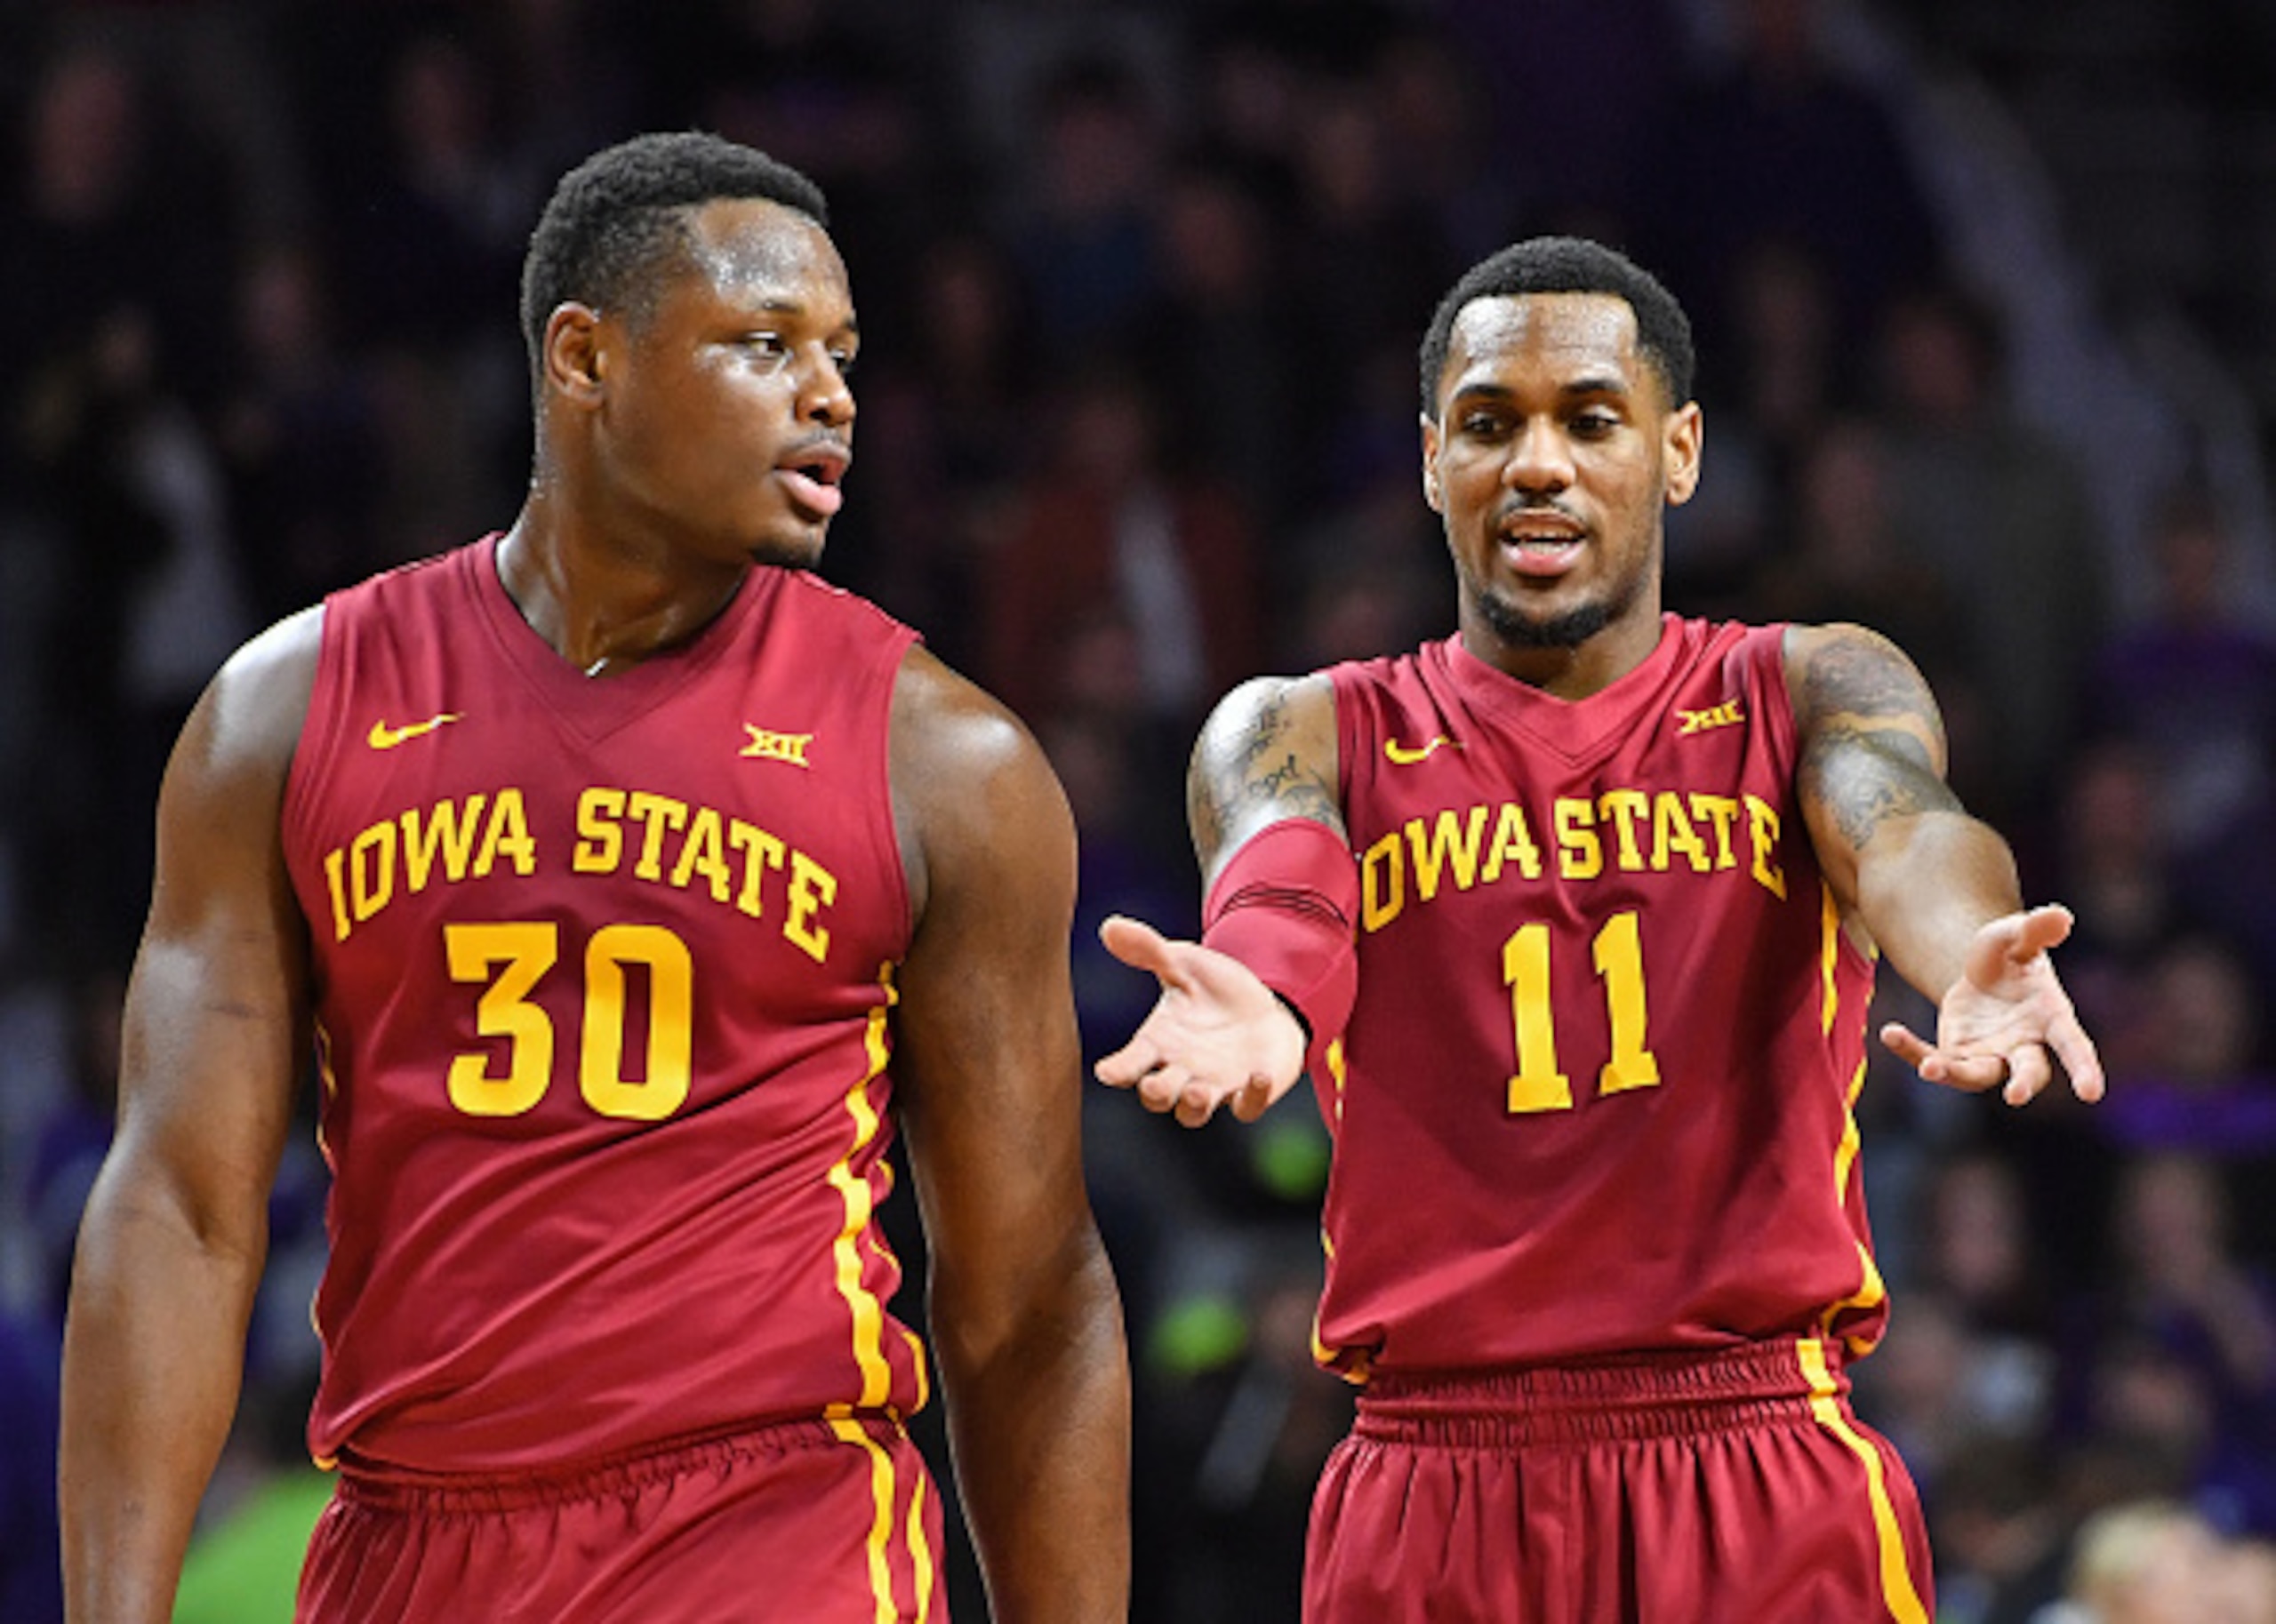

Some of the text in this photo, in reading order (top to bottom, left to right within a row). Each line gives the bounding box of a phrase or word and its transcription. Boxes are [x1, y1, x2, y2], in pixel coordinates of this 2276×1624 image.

[324, 787, 838, 964] IOWA STATE
[1354, 788, 1787, 935] OWA STATE
[443, 921, 693, 1122] 30
[1503, 909, 1662, 1114] 11
